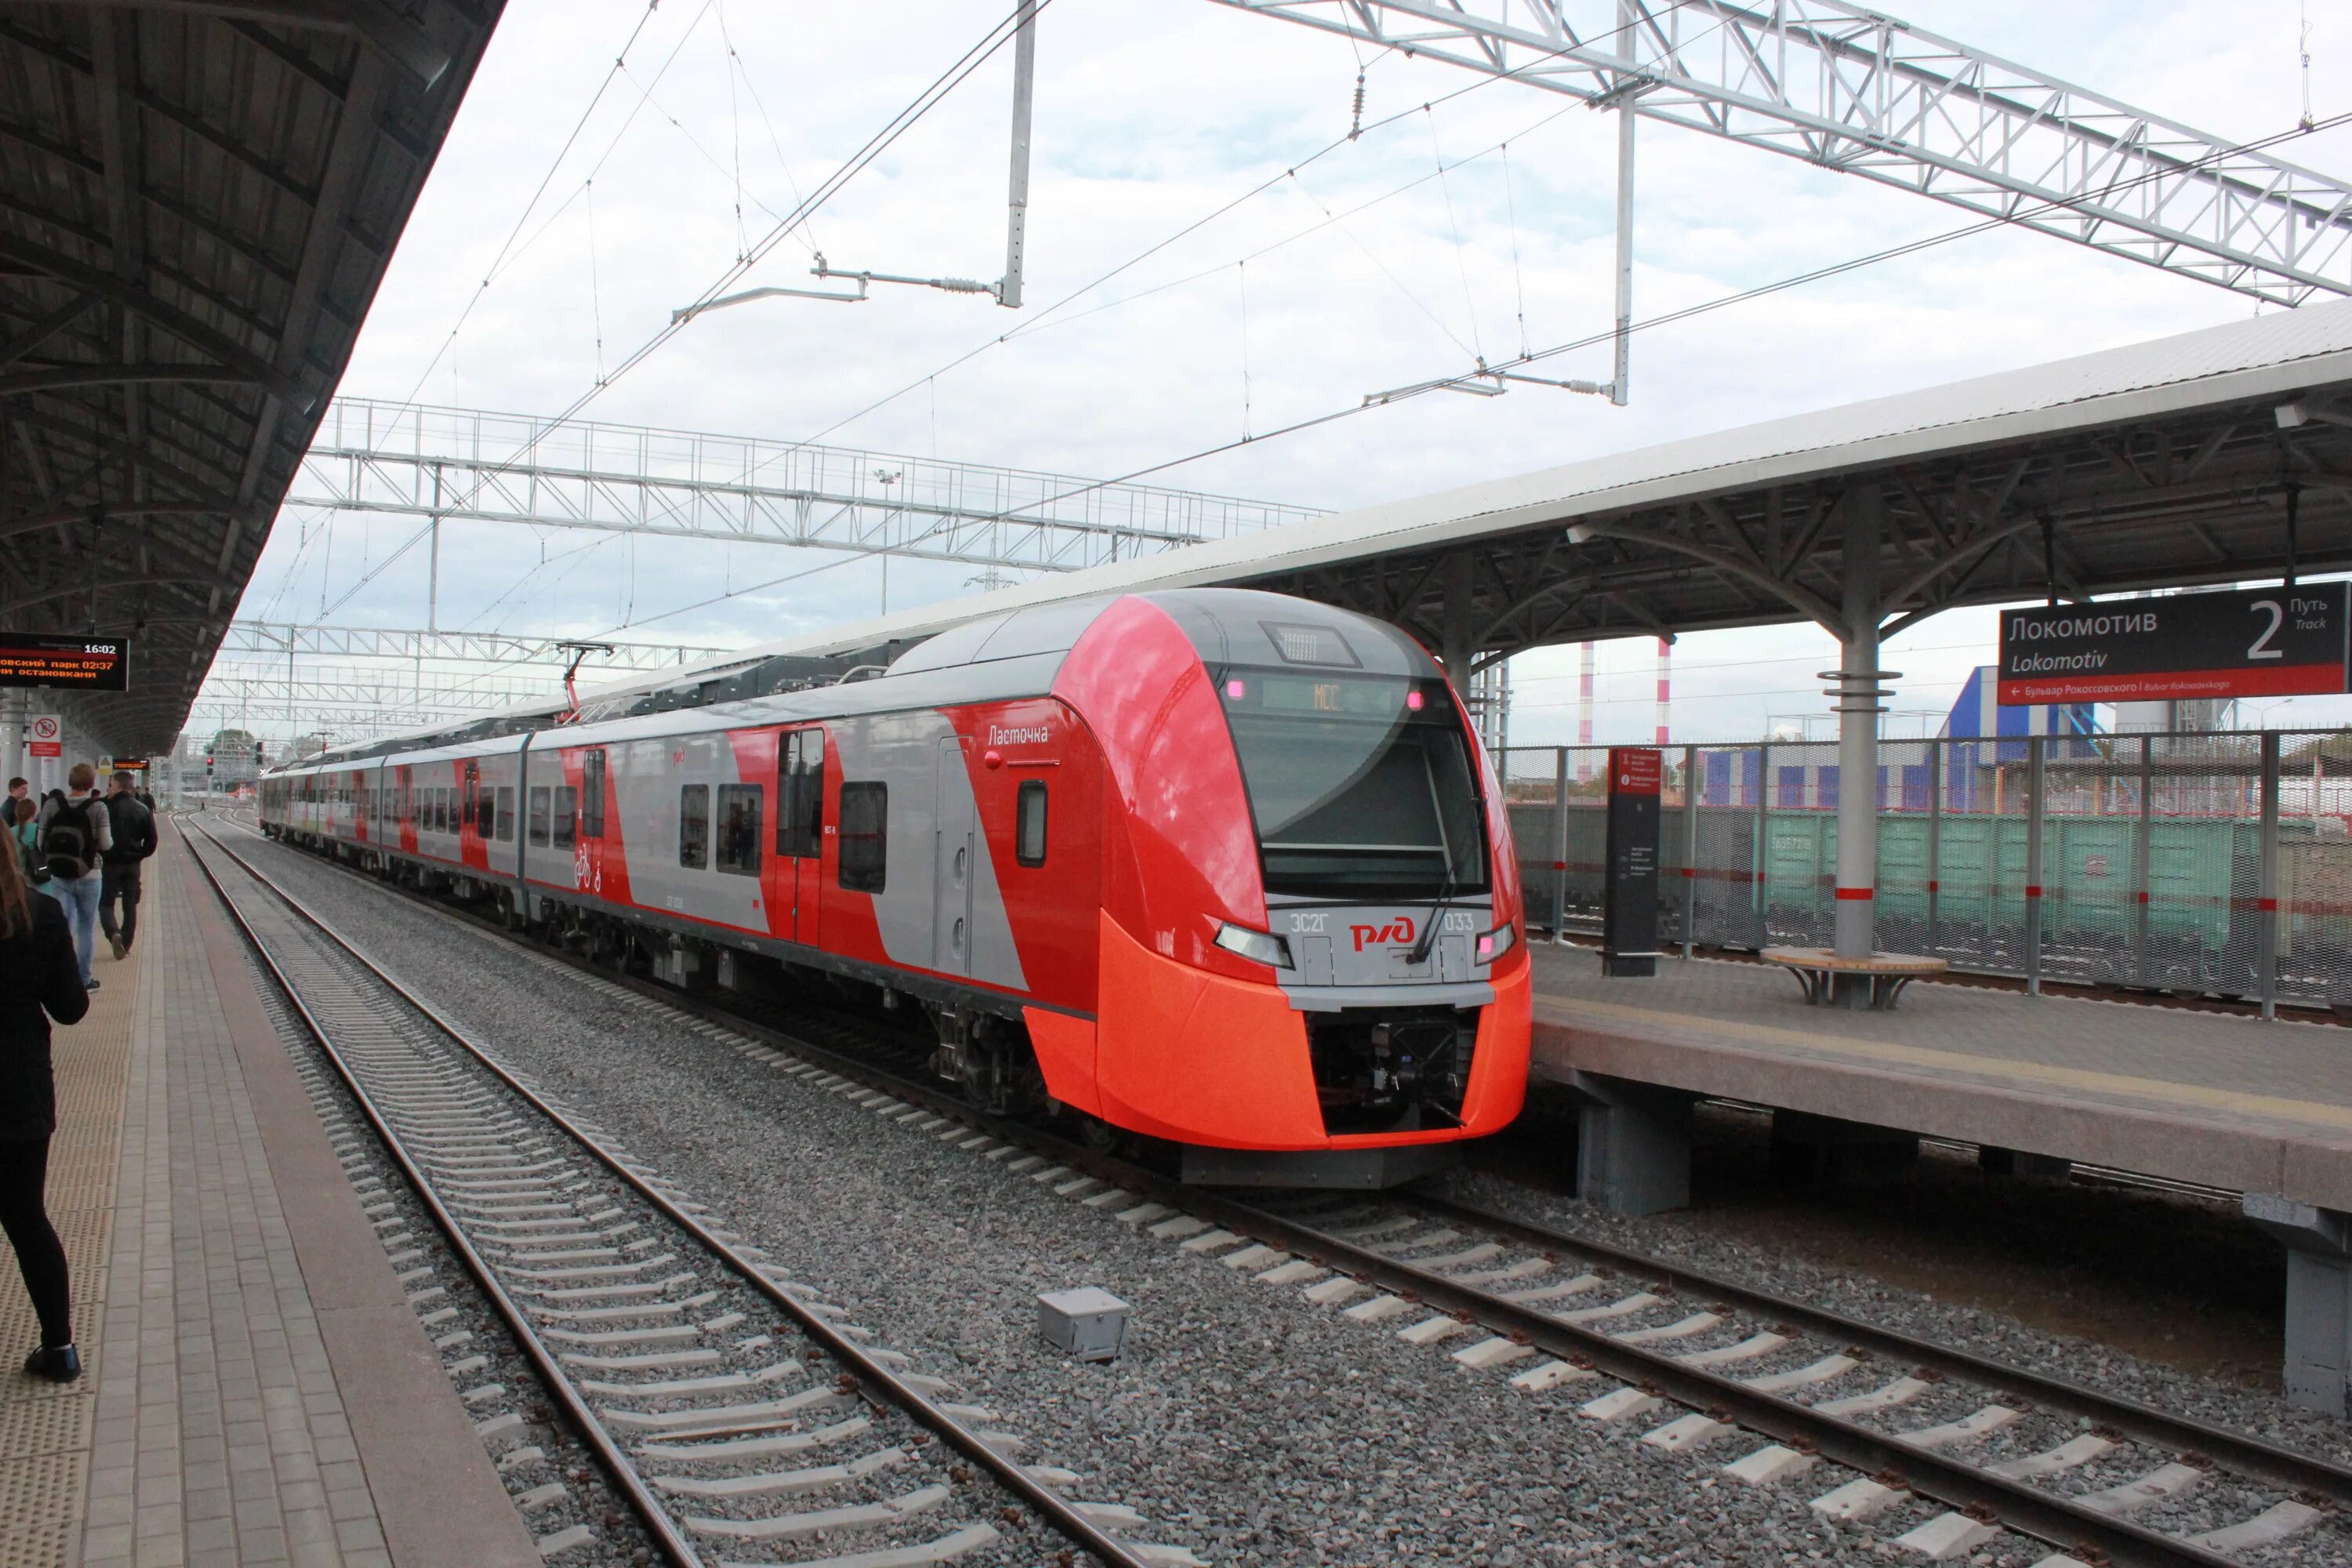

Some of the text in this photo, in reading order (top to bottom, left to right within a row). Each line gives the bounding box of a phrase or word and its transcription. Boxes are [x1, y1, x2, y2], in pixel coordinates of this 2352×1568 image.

[2291, 598, 2328, 616] Путь
[2009, 613, 2158, 642] Локомотив
[2247, 600, 2283, 659] 2
[2296, 617, 2327, 630] Track
[85, 644, 116, 654] 16:02
[82, 662, 114, 670] 02:37
[2012, 650, 2107, 673] Lokomotiv
[18, 669, 96, 678] остановками
[2025, 683, 2137, 697] Бульвар Рокоссовского
[2144, 683, 2169, 691] Bulvar
[988, 725, 1048, 746] Ласточка
[1290, 913, 1329, 932] ЭС2Г
[1443, 913, 1474, 931] 033
